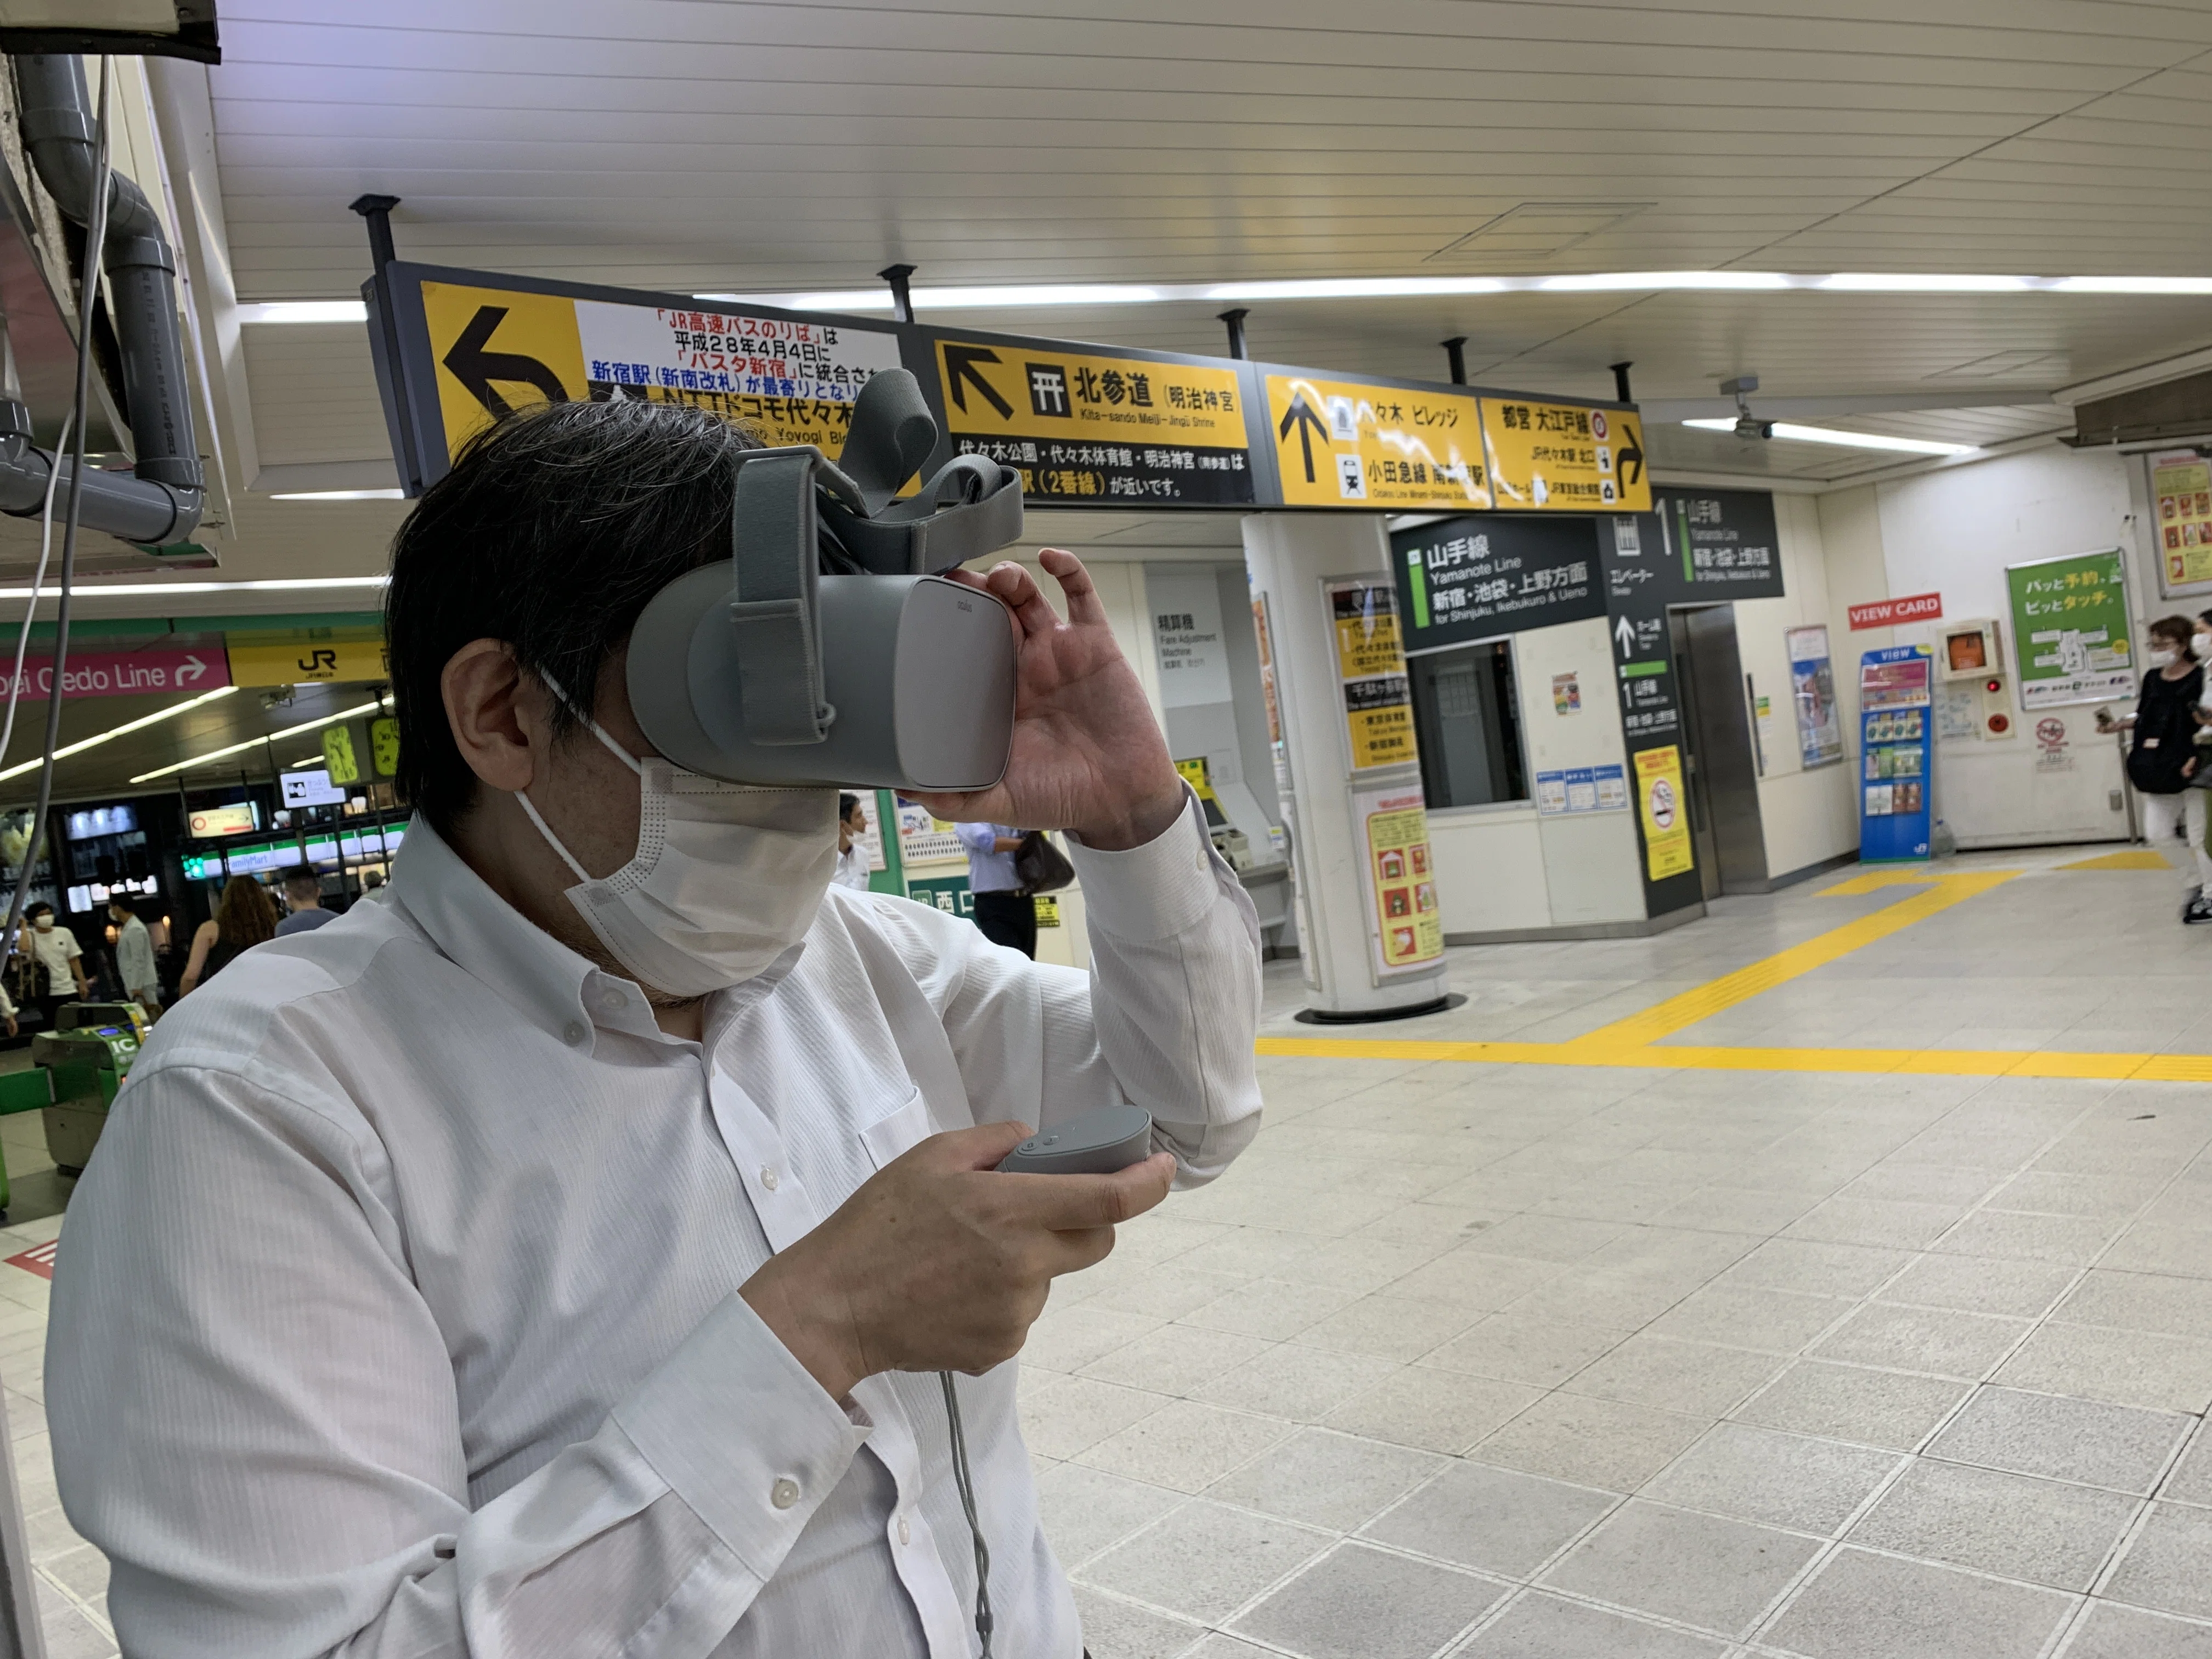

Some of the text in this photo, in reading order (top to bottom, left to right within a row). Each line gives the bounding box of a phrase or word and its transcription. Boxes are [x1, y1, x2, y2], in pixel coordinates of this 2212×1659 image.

[1073, 366, 1154, 408] 北参道
[777, 427, 822, 444] Yoyogi
[1654, 497, 1672, 556] 1
[1426, 533, 1491, 570] 山手線
[1430, 556, 1523, 586] Yamanote Line
[1434, 612, 1450, 625] for
[1558, 585, 1589, 601] Ueno
[1850, 597, 1939, 624] VIEW CARD
[297, 648, 337, 671] JR
[114, 663, 166, 689] Line
[228, 855, 268, 869] amilyMart
[110, 1037, 137, 1054] IC
